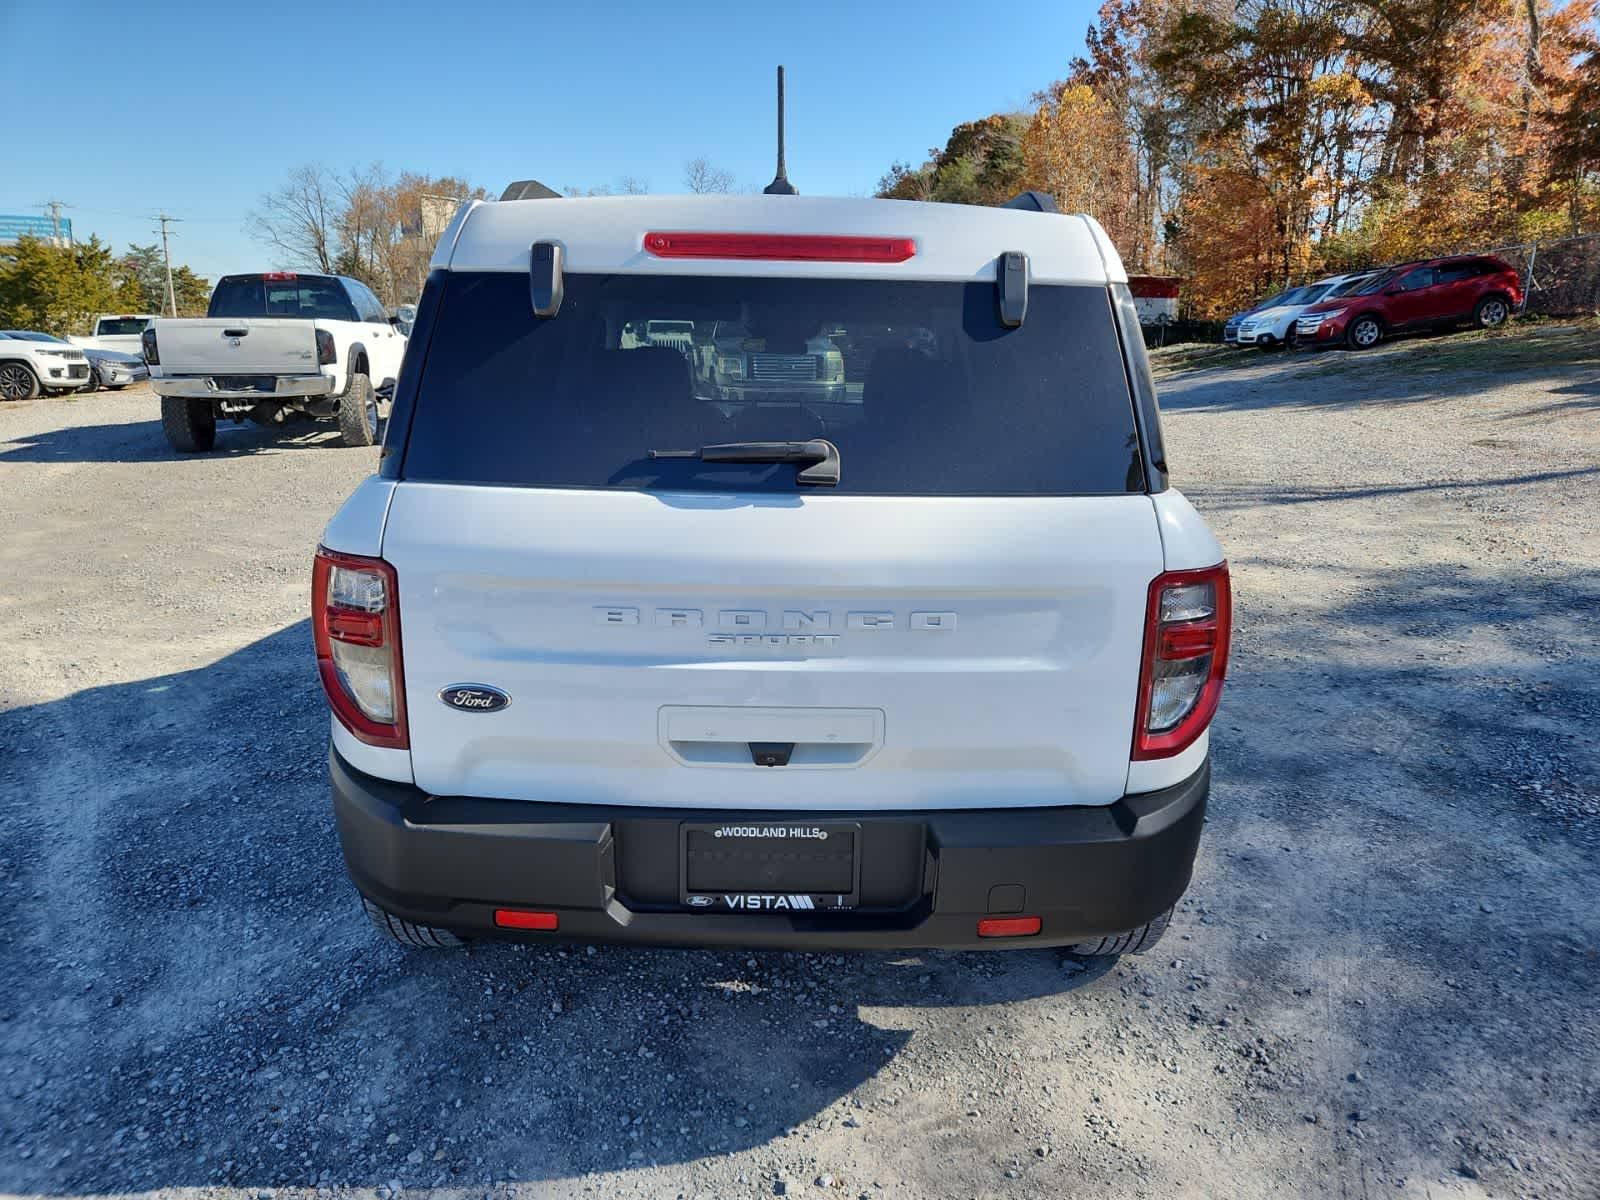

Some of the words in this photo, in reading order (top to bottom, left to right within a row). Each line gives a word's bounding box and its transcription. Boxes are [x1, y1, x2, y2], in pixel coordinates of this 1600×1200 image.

[592, 605, 959, 632] BRONCO
[706, 633, 840, 648] SPORT
[454, 690, 494, 708] Ford
[721, 826, 787, 838] WOODLAND
[788, 827, 820, 839] HILLS
[723, 895, 792, 910] VISTA
